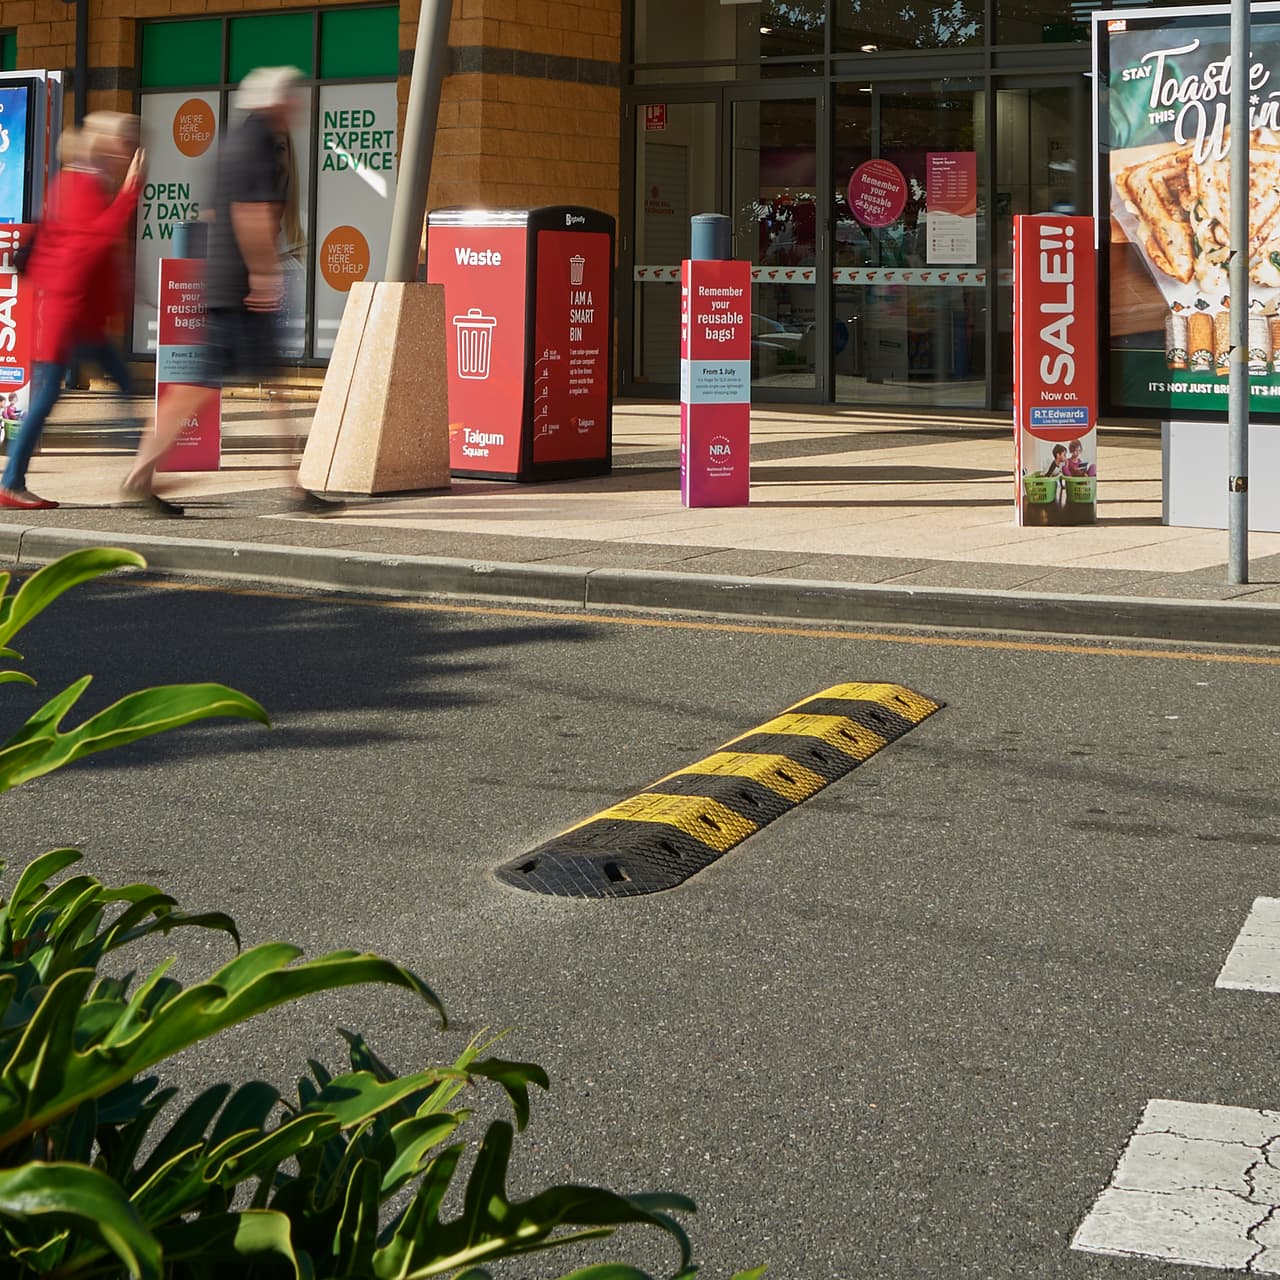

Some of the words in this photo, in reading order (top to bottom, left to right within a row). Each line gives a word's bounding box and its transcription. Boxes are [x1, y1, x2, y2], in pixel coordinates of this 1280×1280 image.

[1122, 65, 1152, 81] STAY
[1141, 38, 1270, 108] Toaste
[179, 115, 203, 124] WE'RE
[324, 110, 376, 129] NEED
[1149, 109, 1175, 125] THIS
[179, 124, 199, 133] HERE
[179, 132, 191, 142] TO
[192, 132, 210, 142] HELP
[324, 130, 394, 150] EXPERT
[322, 151, 397, 171] ADVICE
[861, 173, 900, 192] Remember
[143, 183, 190, 201] OPEN
[870, 186, 887, 197] your
[860, 192, 892, 208] reusable
[144, 203, 152, 220] 7
[157, 202, 200, 220] DAYS
[863, 200, 885, 216] bags!
[142, 226, 153, 240] A
[328, 244, 355, 255] WE'RE
[455, 247, 501, 266] Waste
[328, 254, 350, 264] HERE
[328, 263, 341, 274] TO
[342, 263, 364, 274] HELP
[181, 293, 201, 303] your
[570, 291, 574, 305] I
[574, 291, 586, 305] AM
[587, 291, 593, 305] A
[698, 286, 743, 297] Remember
[711, 300, 730, 311] your
[1039, 225, 1075, 385] SALE!!
[570, 309, 594, 323] SMART
[697, 311, 743, 324] reusable
[570, 327, 583, 342] BIN
[705, 327, 735, 342] bags!
[724, 368, 736, 376] July
[1148, 382, 1165, 392] IT'S
[1167, 383, 1187, 393] NOT
[1188, 383, 1213, 394] JUST
[1251, 385, 1268, 395] IT'S
[1041, 392, 1062, 401] Now
[1063, 393, 1078, 401] on.
[463, 428, 503, 446] Taigum
[462, 445, 489, 457] Square
[709, 444, 731, 455] NRA
